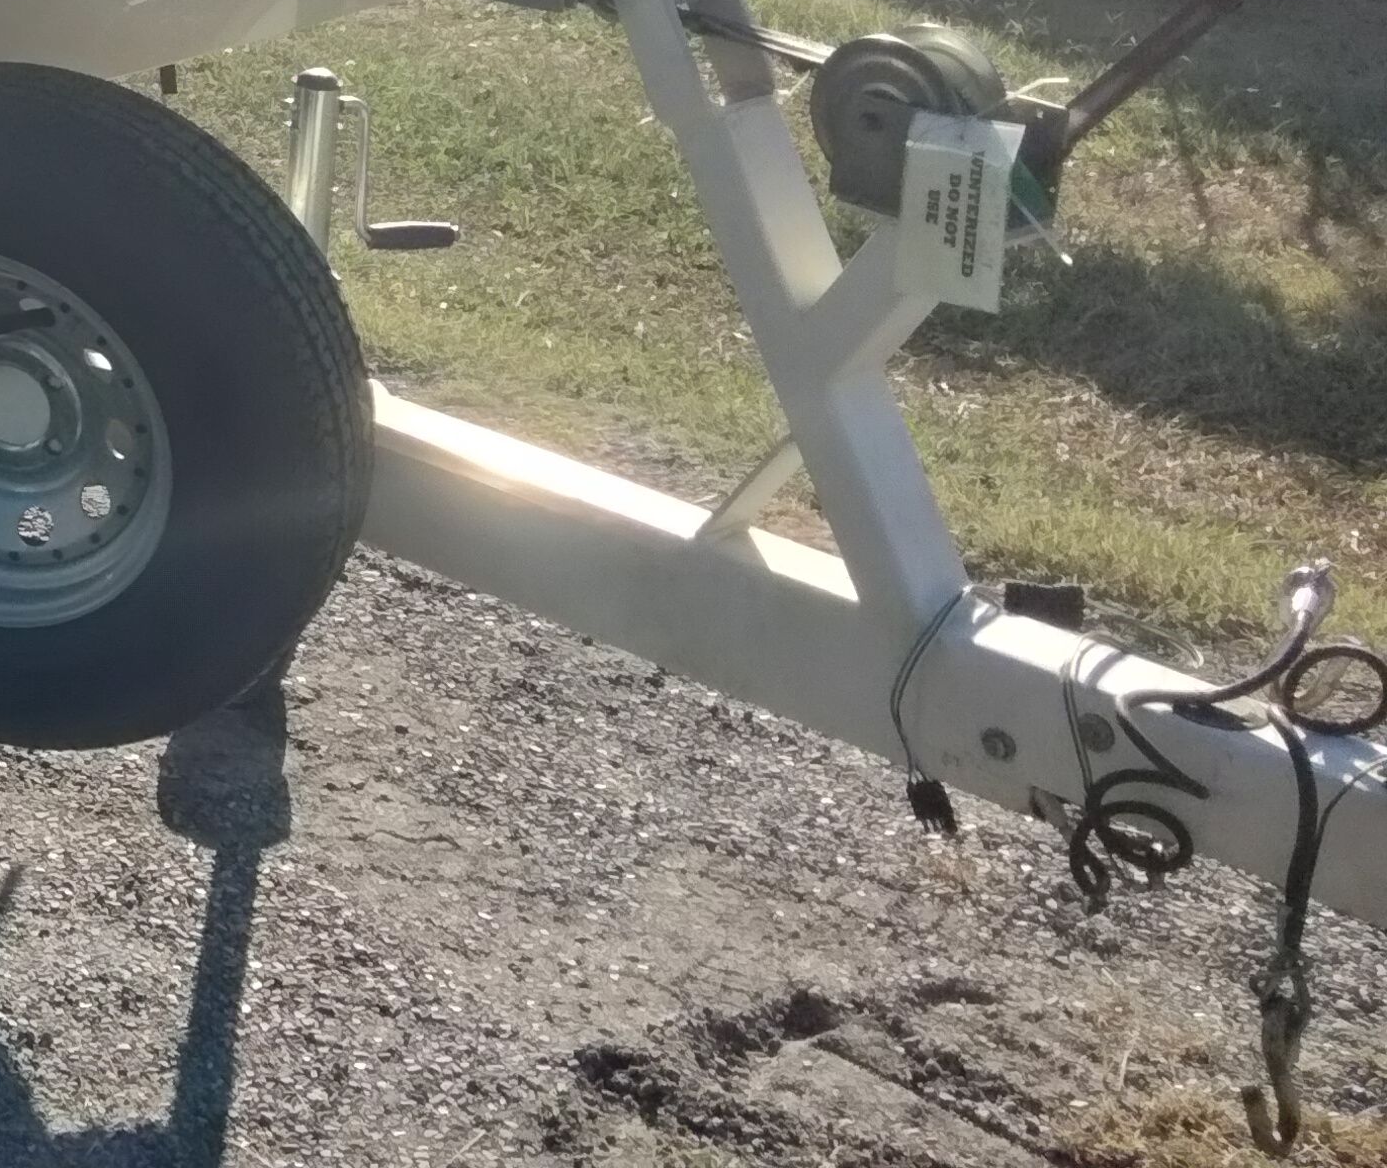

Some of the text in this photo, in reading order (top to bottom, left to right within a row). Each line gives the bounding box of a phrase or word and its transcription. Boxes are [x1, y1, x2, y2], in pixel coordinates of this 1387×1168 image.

[925, 189, 941, 225] USE
[943, 173, 962, 248] DO NOT
[961, 150, 985, 278] WINTERIZED
